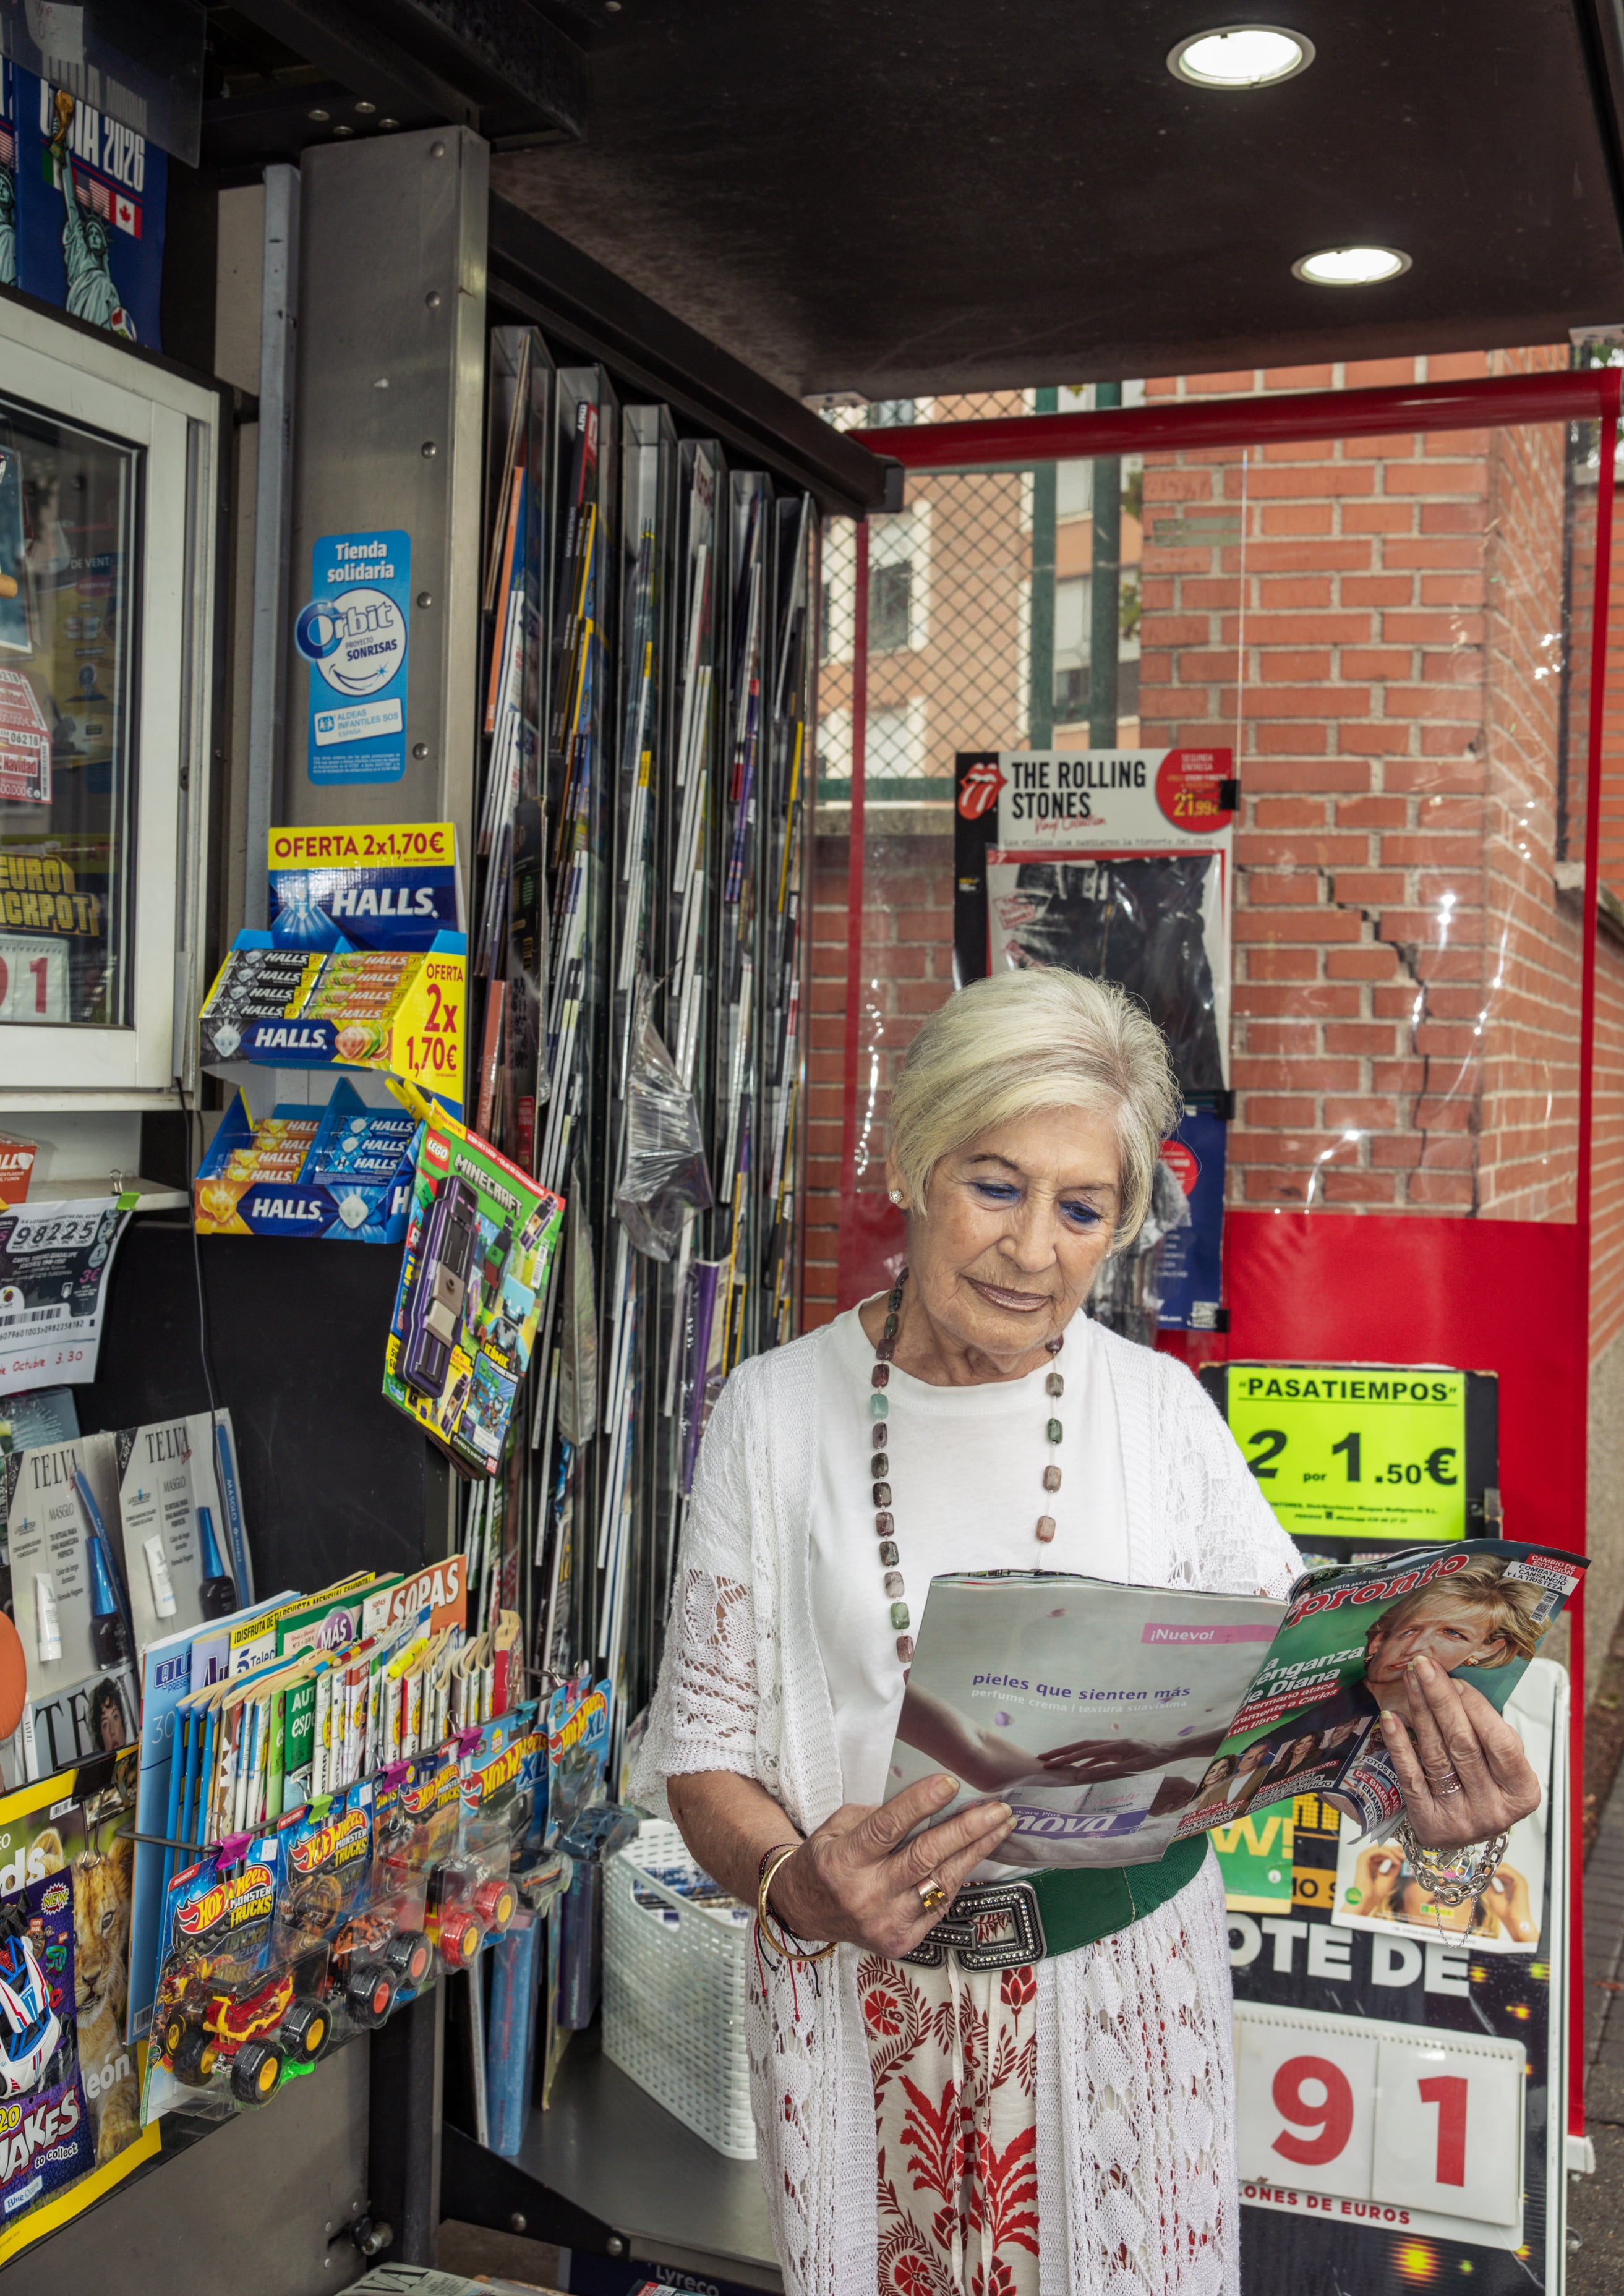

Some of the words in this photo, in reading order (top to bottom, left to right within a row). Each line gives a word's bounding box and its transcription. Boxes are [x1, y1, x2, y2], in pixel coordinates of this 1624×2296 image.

[103, 116, 145, 193] 2026
[336, 540, 387, 561] Tienda
[327, 561, 395, 583] solidaria
[297, 601, 393, 659] Orbit
[346, 637, 374, 649] PROYECTO
[347, 639, 397, 661] SONRISAS
[338, 709, 366, 720] ALDEAS
[338, 715, 381, 729] INFANTILES
[383, 712, 398, 722] SOS
[4, 758, 36, 775] Navidad
[1012, 761, 1050, 789] THE
[1058, 761, 1146, 788] ROLLING
[1012, 793, 1090, 819] STONES
[275, 836, 358, 859] OFERTA
[364, 832, 444, 859] 2x1,70€
[331, 887, 440, 919] HALLS
[426, 963, 463, 983] OFERTA
[424, 983, 457, 1033] 2x
[255, 1028, 327, 1049] HALLS
[406, 1037, 456, 1077] 1,70€
[427, 1138, 448, 1160] LEGO
[454, 1153, 521, 1219] MINECRAFT
[252, 1198, 323, 1221] HALLS
[12, 1221, 96, 1245] 98225
[79, 1268, 100, 1283] 3€
[12, 1356, 45, 1372] Octubre
[145, 1426, 190, 1463] TELVA
[1247, 1430, 1288, 1479] 2
[1304, 1472, 1326, 1484] por
[31, 1448, 77, 1490] TELVA
[1519, 1564, 1559, 1578] COMBATE
[1532, 1555, 1564, 1568] CAMBIO
[1565, 1564, 1576, 1572] DE
[1532, 1561, 1573, 1576] ESTACIÓN
[1323, 1584, 1351, 1595] REVISTA
[1351, 1579, 1368, 1588] MÁS
[1368, 1574, 1397, 1585] VENDIDA
[1405, 1563, 1430, 1575] ESPAÑA
[1518, 1569, 1566, 1586] CANSANCIO
[1525, 1576, 1562, 1592] TRISTEZA
[393, 1562, 458, 1620] SOPAS
[1286, 1554, 1470, 1629] pronto
[234, 1621, 265, 1644] ¡DISFRUTA
[267, 1616, 273, 1629] DE
[321, 1617, 347, 1649] MÁS
[1150, 1628, 1214, 1642] ¡Nuevo!
[972, 1674, 1029, 1690] pieles
[1036, 1683, 1072, 1698] que
[1079, 1689, 1147, 1701] sienten
[1153, 1686, 1190, 1699] más
[1267, 1668, 1341, 1697] Diana
[971, 1688, 1025, 1705] perfume
[1028, 1698, 1067, 1712] crema
[1079, 1705, 1122, 1714] textura
[1126, 1700, 1187, 1712] suavísima
[1244, 1691, 1298, 1713] hermano
[1301, 1683, 1335, 1695] ataca
[1298, 1689, 1337, 1705] Carlos
[586, 1709, 604, 1739] XL
[1233, 1723, 1247, 1735] un
[1250, 1713, 1279, 1729] libro
[520, 1750, 547, 1789] XL
[1259, 1780, 1286, 1793] CINDY
[1286, 1760, 1336, 1781] CRAWFORD
[1362, 1756, 1388, 1773] FOTOS
[1356, 1771, 1370, 1781] DE
[1369, 1778, 1390, 1802] BIMBA
[1184, 1812, 1211, 1824] JORGE
[1215, 1799, 1244, 1813] JAVIER
[1197, 1816, 1212, 1824] VEZ
[1199, 1801, 1223, 1813] ROSA
[326, 1812, 364, 1851] WHEELS
[335, 1828, 367, 1850] MONSTER
[335, 1837, 367, 1867] TRUCKS
[43, 1890, 69, 1908] NEW
[196, 1886, 225, 1931] HOT
[221, 1869, 267, 1902] WHEELS
[230, 1885, 271, 1908] MONSTER
[229, 1895, 272, 1929] TRUCKS
[1371, 1933, 1470, 1997] DE
[22, 1987, 33, 2000] SUPER
[35, 2155, 45, 2168] to
[48, 2143, 78, 2160] collect
[7, 2193, 24, 2208] Blue
[25, 2181, 39, 2198] Ocean
[1307, 2195, 1332, 2211] DE
[1341, 2201, 1410, 2224] EUROS
[656, 2266, 719, 2296] Lyreco
